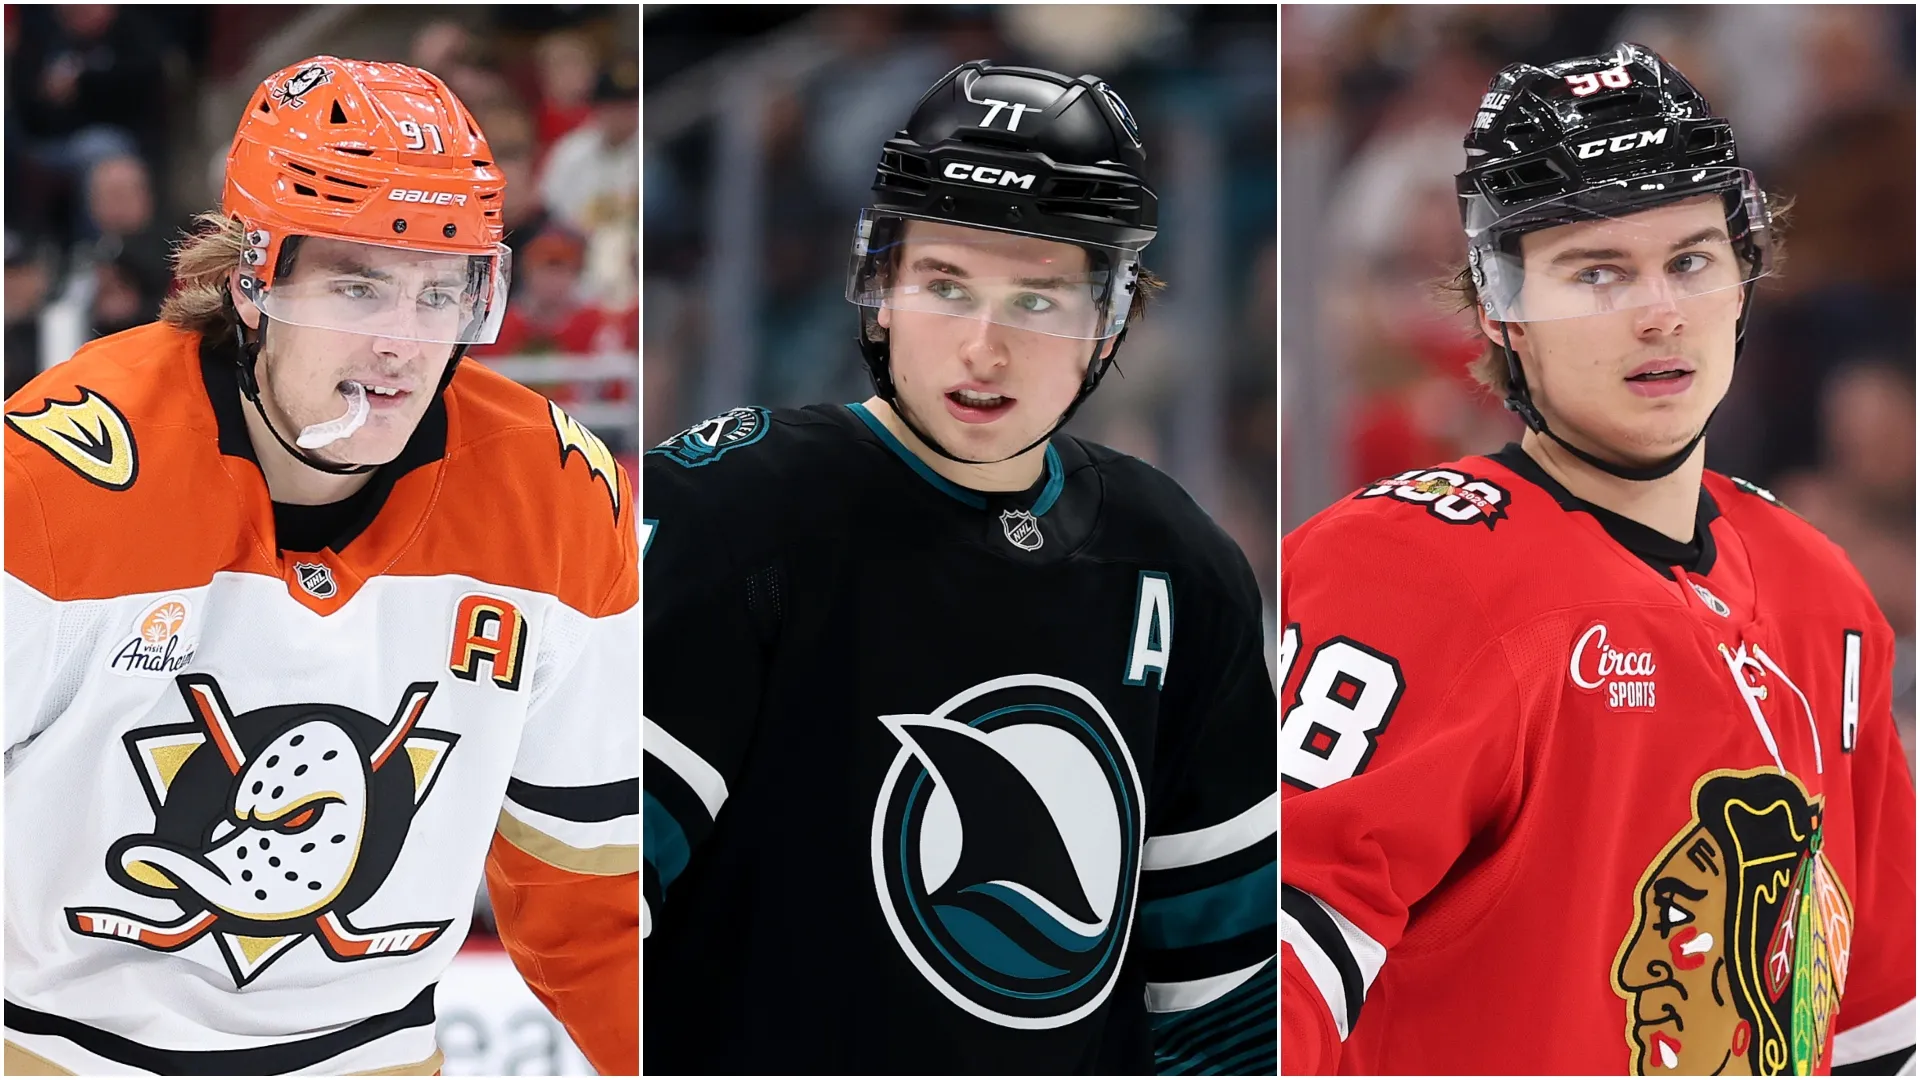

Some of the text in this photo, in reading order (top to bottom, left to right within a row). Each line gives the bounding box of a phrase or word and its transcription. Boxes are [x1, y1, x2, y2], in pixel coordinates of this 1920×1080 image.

[979, 98, 1026, 132] 71
[399, 120, 445, 154] 91
[1577, 127, 1668, 160] CCM
[943, 162, 1036, 190] CCM
[1458, 489, 1487, 508] 2026
[1013, 522, 1032, 542] NHL
[306, 572, 326, 589] NHL
[450, 594, 528, 692] A
[1122, 570, 1175, 691] A
[144, 644, 163, 654] visit
[1569, 624, 1656, 689] Circa
[1608, 681, 1656, 708] SPORTS
